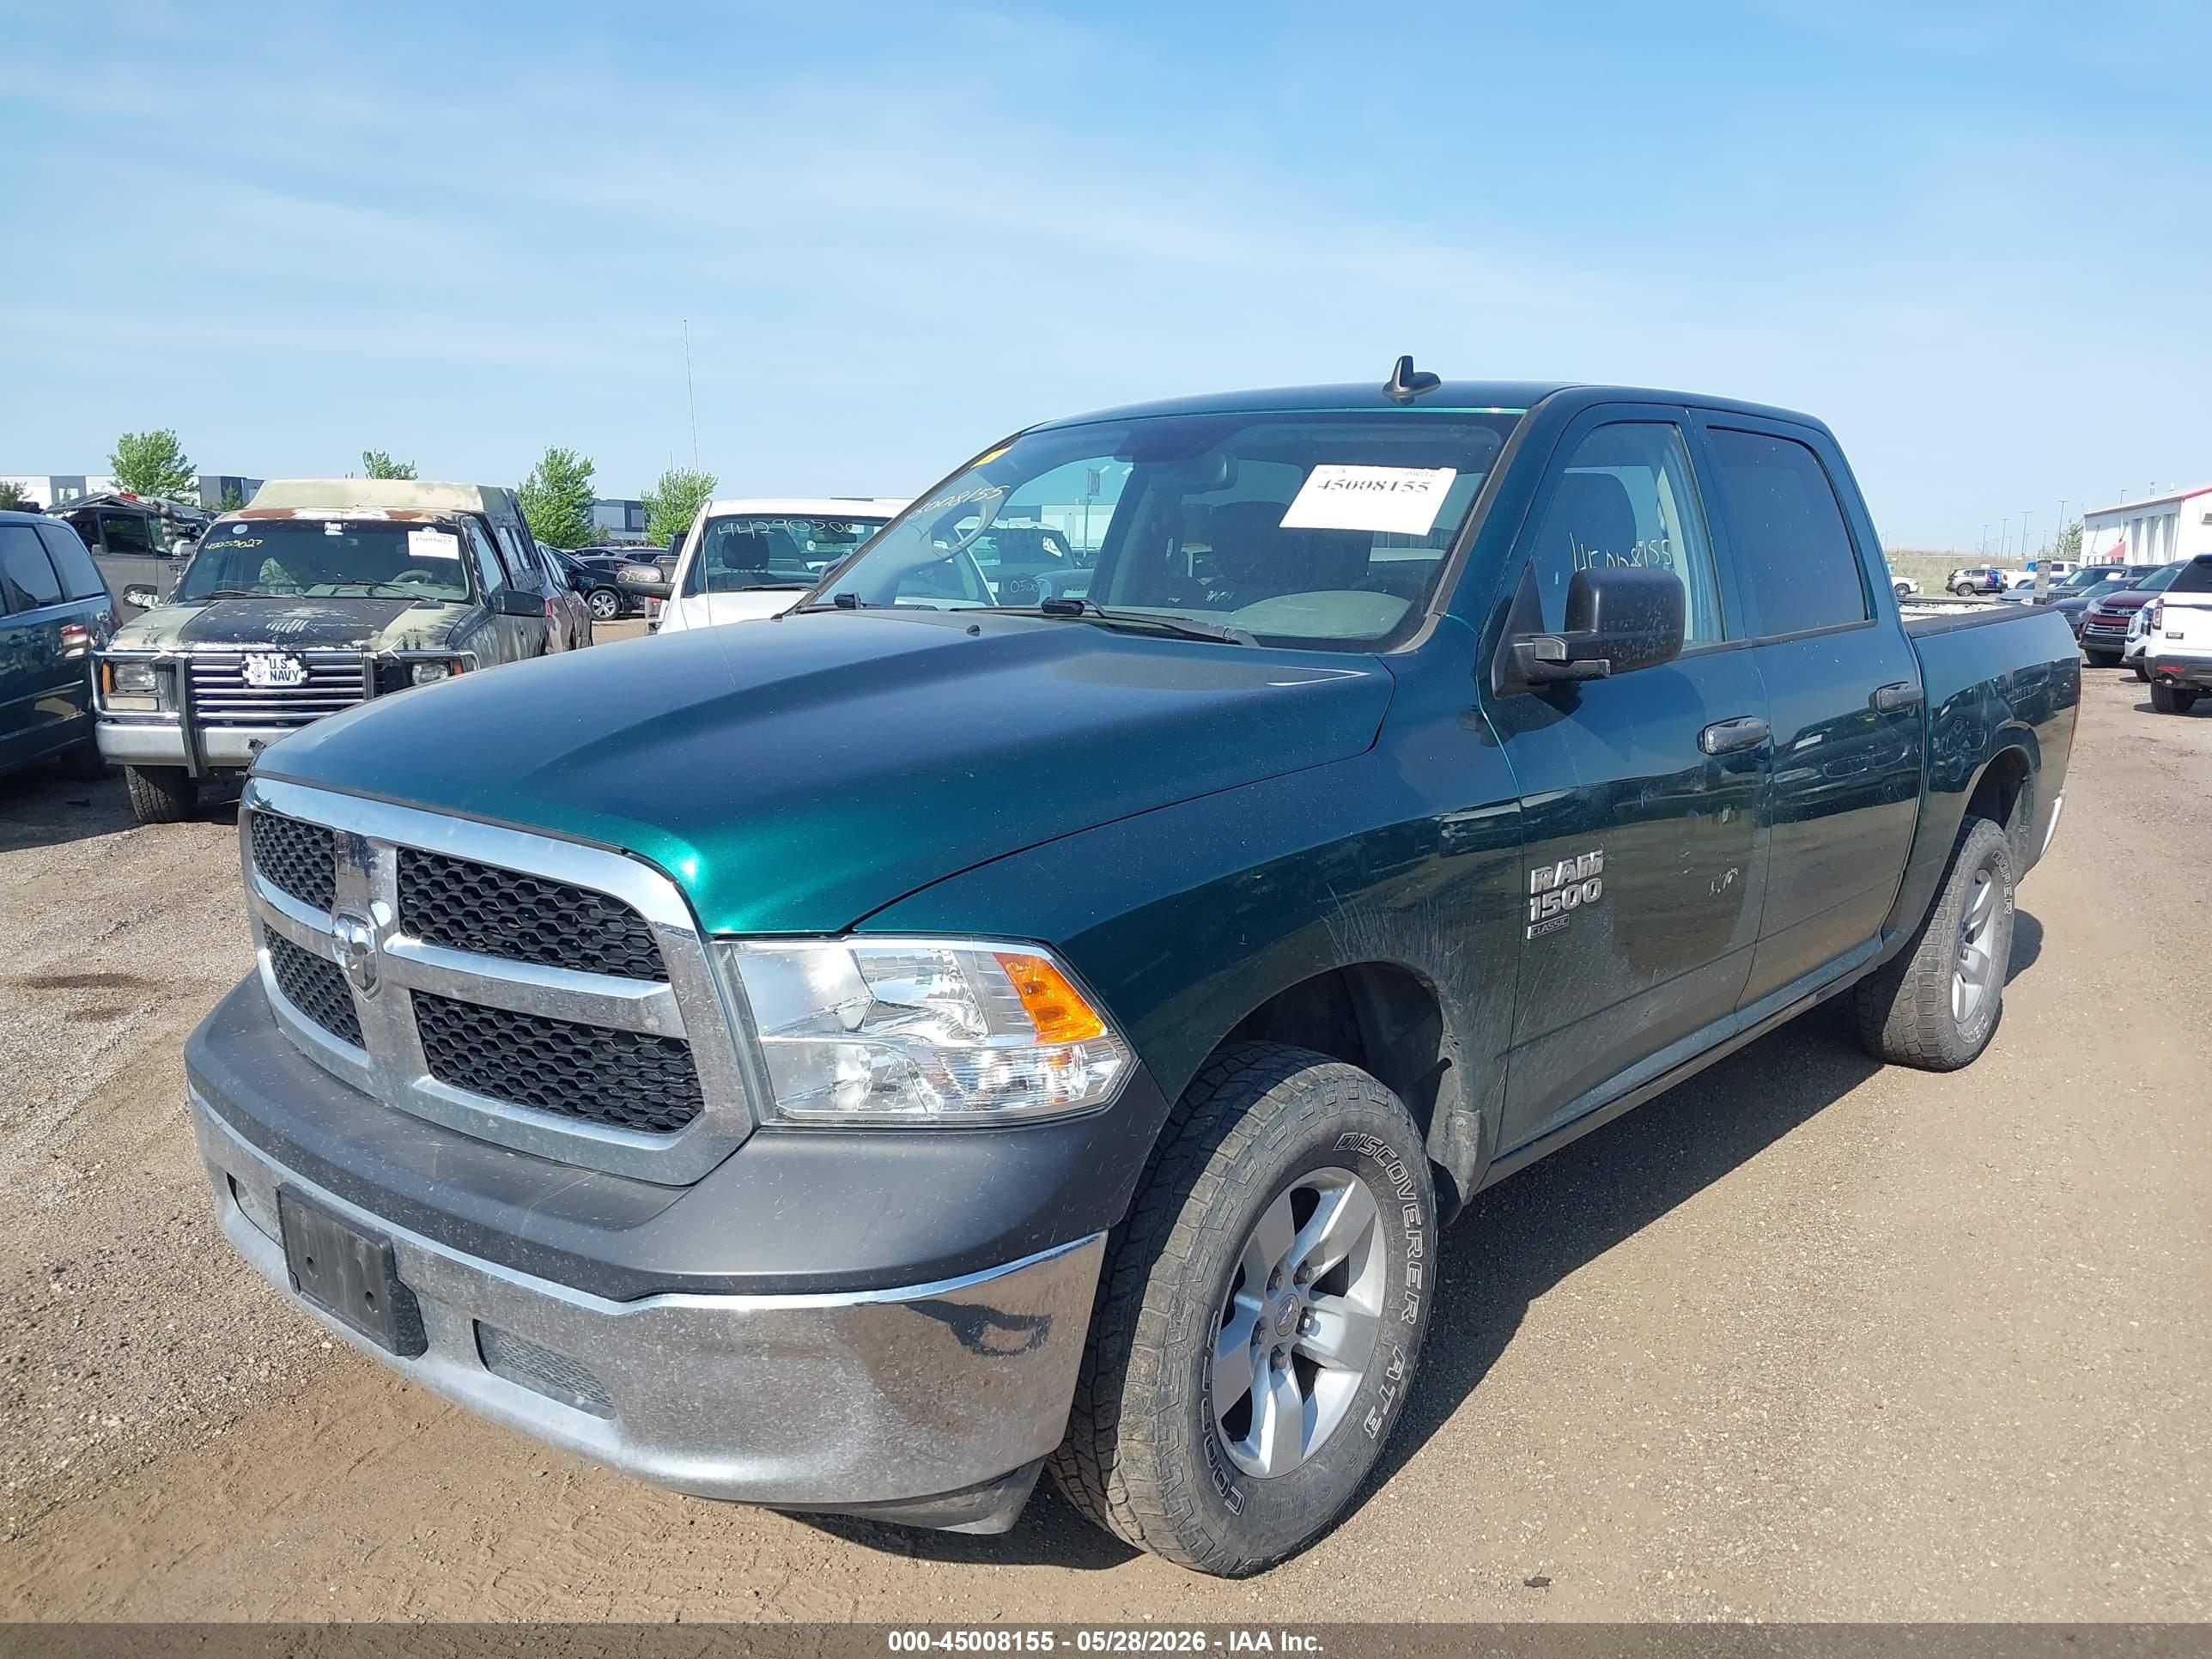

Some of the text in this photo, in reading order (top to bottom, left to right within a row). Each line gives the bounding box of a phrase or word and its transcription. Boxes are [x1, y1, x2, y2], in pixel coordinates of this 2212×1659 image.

[1317, 478, 1431, 493] 45008155
[269, 658, 290, 670] U.S.
[270, 670, 300, 683] NAVY
[1530, 849, 1603, 895] RAM
[1529, 877, 1603, 922] 1500
[1530, 916, 1569, 937] CLASSIC
[1332, 1132, 1424, 1326] DISCOVERER
